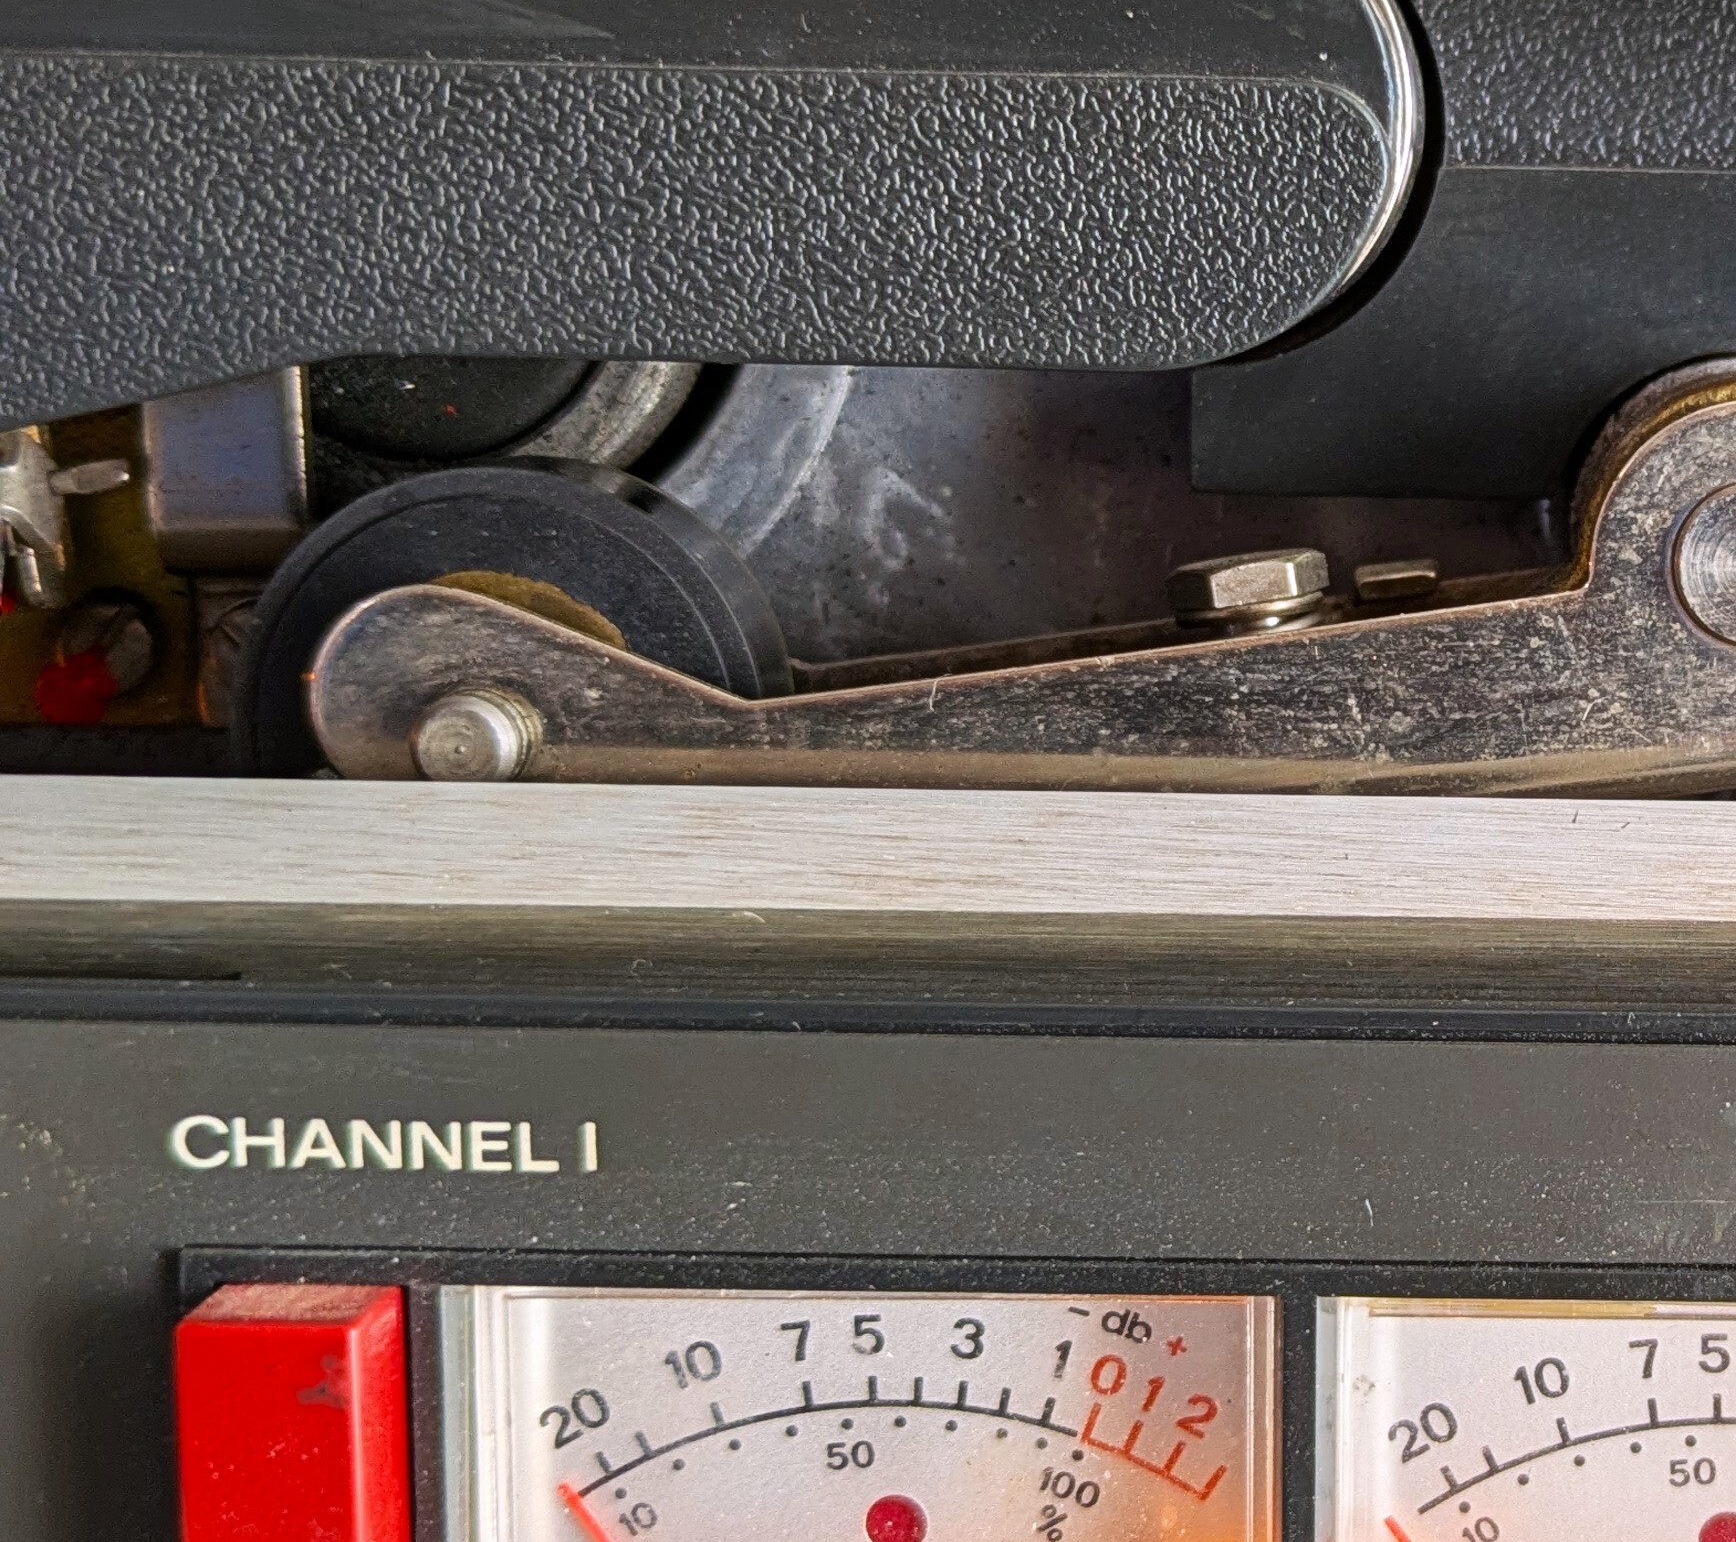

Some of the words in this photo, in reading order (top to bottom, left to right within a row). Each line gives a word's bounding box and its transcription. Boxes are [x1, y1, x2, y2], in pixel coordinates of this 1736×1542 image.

[169, 1114, 560, 1173] CHANNEL
[581, 1121, 598, 1173] I
[1101, 1309, 1153, 1345] db
[539, 1388, 611, 1450] 20
[664, 1340, 723, 1389] 10
[780, 1319, 811, 1362] 7
[852, 1314, 885, 1356] 5
[950, 1317, 986, 1360] 3
[1053, 1339, 1072, 1379] 1
[1090, 1353, 1127, 1396] 0
[1141, 1375, 1166, 1413] 1
[1176, 1393, 1219, 1439] 2
[1388, 1402, 1458, 1464] 20
[1513, 1357, 1570, 1405] 10
[1629, 1338, 1659, 1379] 7
[1699, 1332, 1731, 1374] 5
[618, 1501, 658, 1537] 10
[826, 1440, 875, 1471] 50
[1039, 1465, 1100, 1508] 100
[1668, 1457, 1717, 1488] 50
[1035, 1503, 1068, 1542] %
